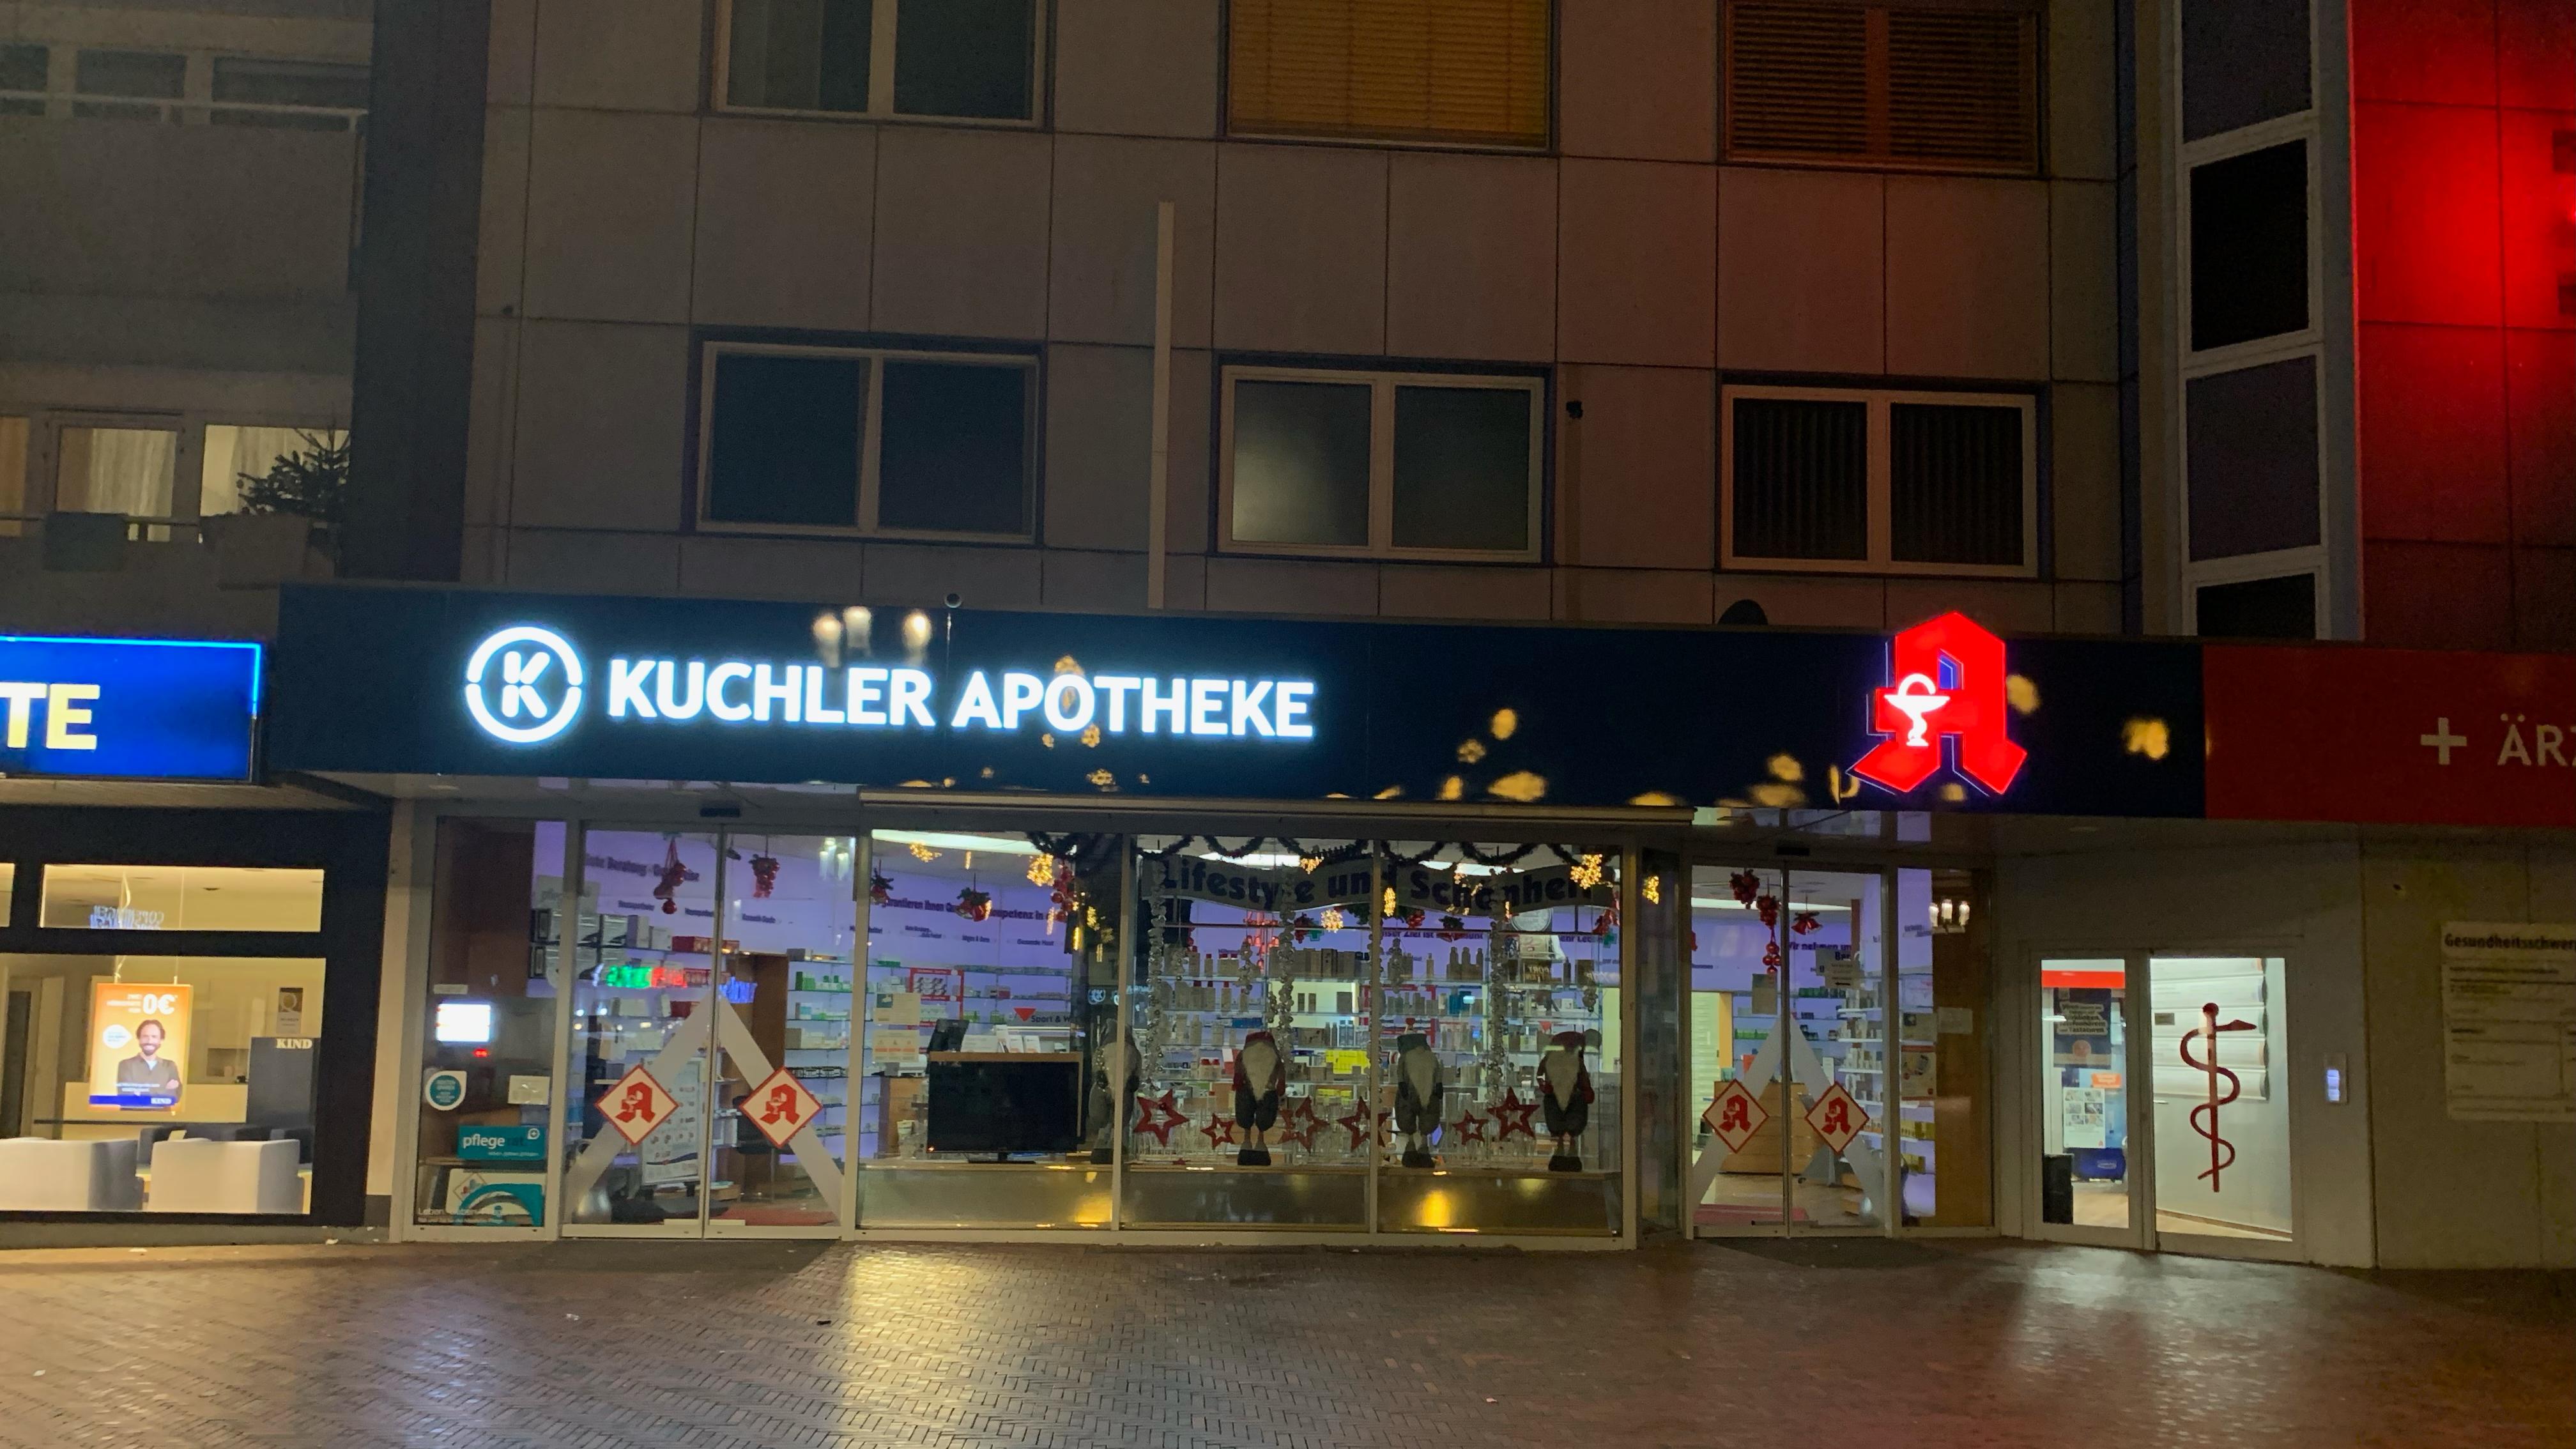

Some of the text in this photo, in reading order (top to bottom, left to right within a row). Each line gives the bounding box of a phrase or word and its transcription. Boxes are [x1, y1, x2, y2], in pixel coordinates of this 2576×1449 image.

[0, 682, 100, 750] TE
[607, 659, 1314, 737] KUCHLER APOTHEKE
[2497, 713, 2576, 767] ÄR
[276, 1038, 313, 1049] KIND
